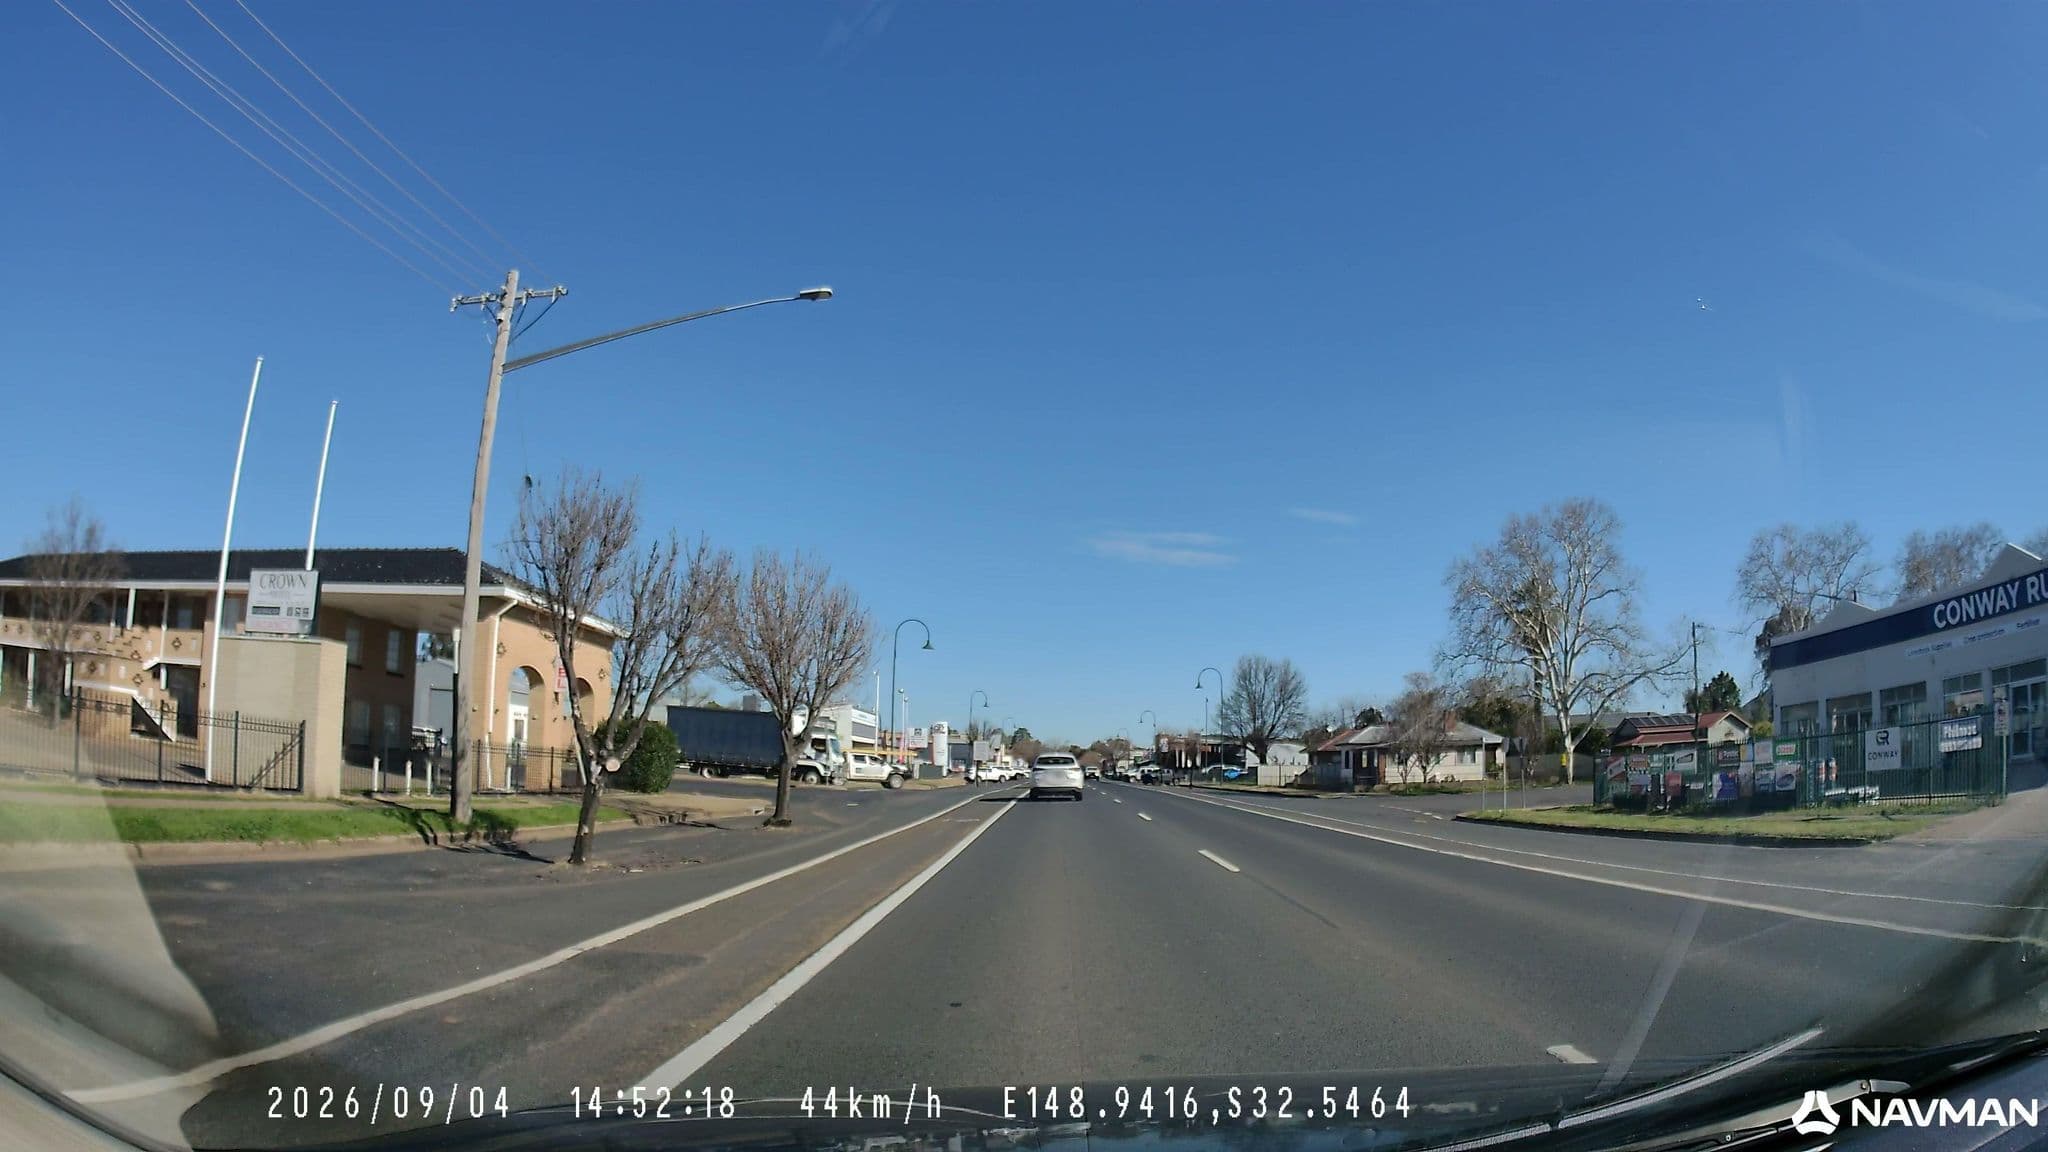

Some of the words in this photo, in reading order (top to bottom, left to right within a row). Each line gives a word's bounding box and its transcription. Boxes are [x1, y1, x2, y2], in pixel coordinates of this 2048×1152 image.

[259, 573, 309, 590] CROWN
[1933, 581, 2020, 629] CONWAY
[1867, 750, 1899, 761] CONWAY
